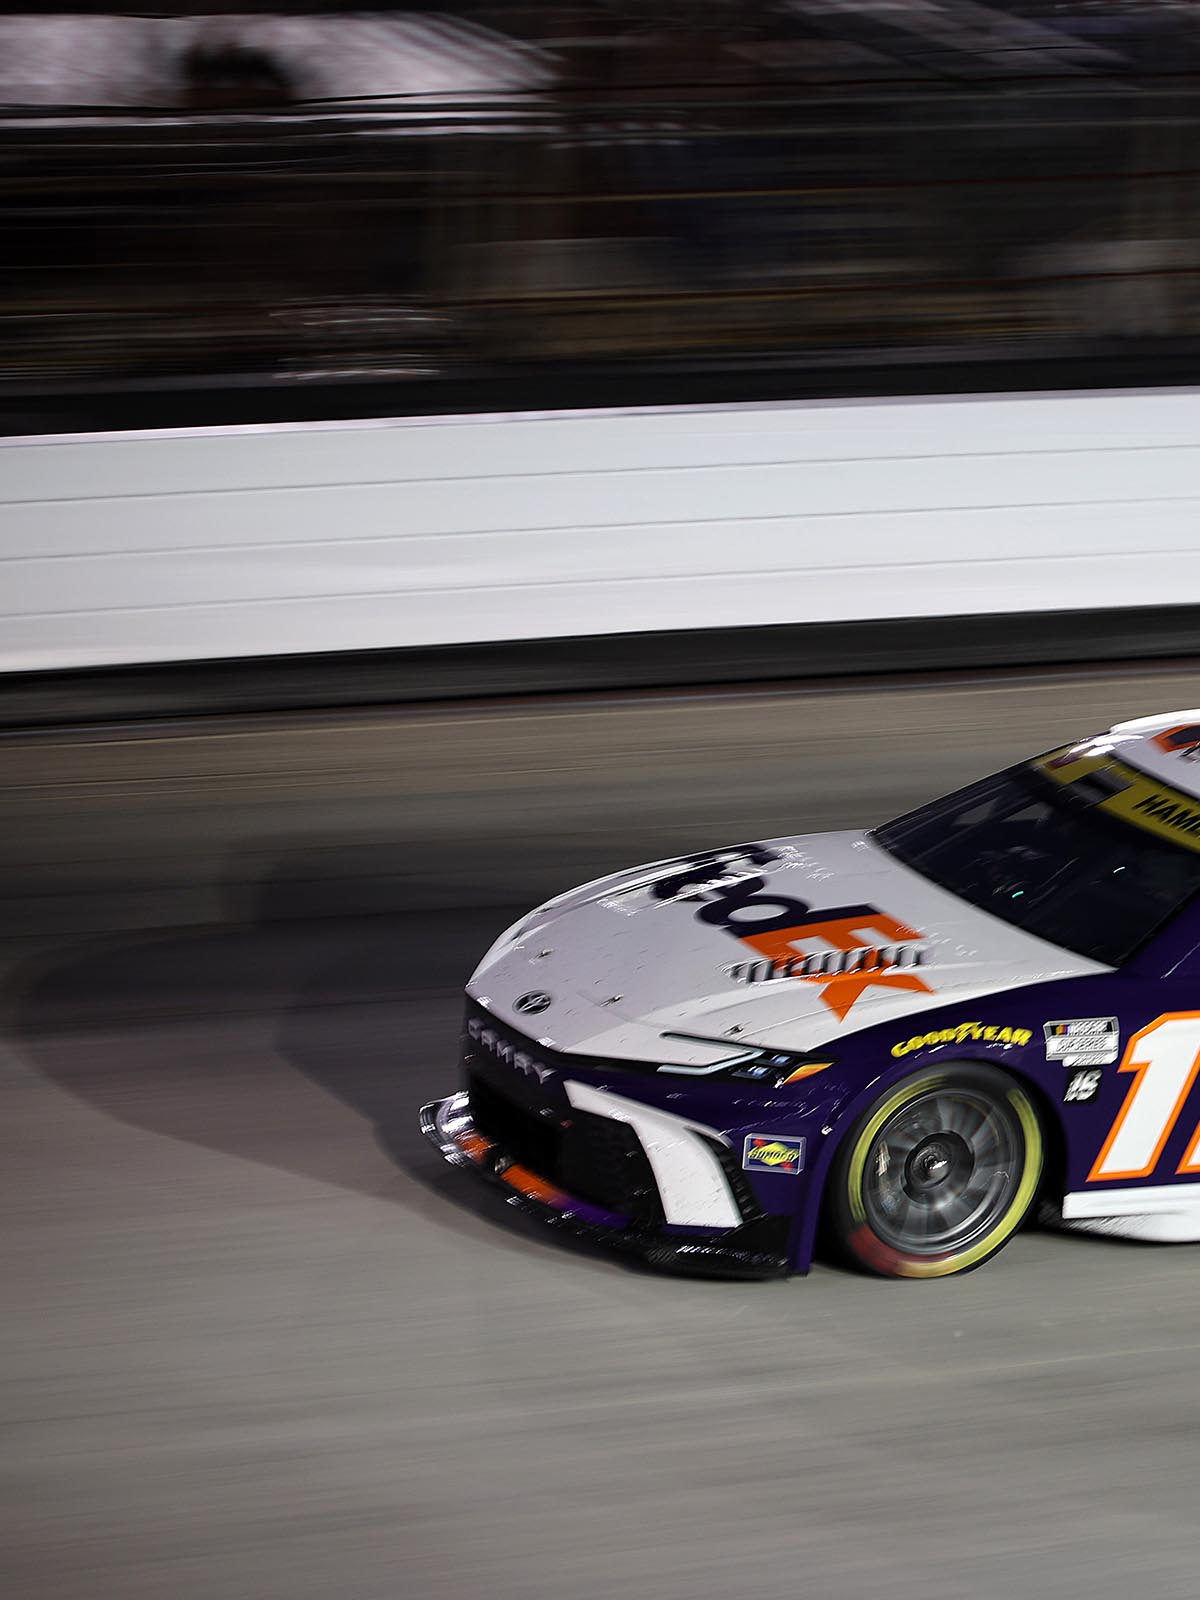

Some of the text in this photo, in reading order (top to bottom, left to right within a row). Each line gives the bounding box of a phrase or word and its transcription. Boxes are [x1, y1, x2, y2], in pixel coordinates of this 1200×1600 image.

[468, 1018, 557, 1085] CAMRY
[891, 1021, 1033, 1058] GOODYEAR
[747, 1148, 801, 1162] SUNOCO
